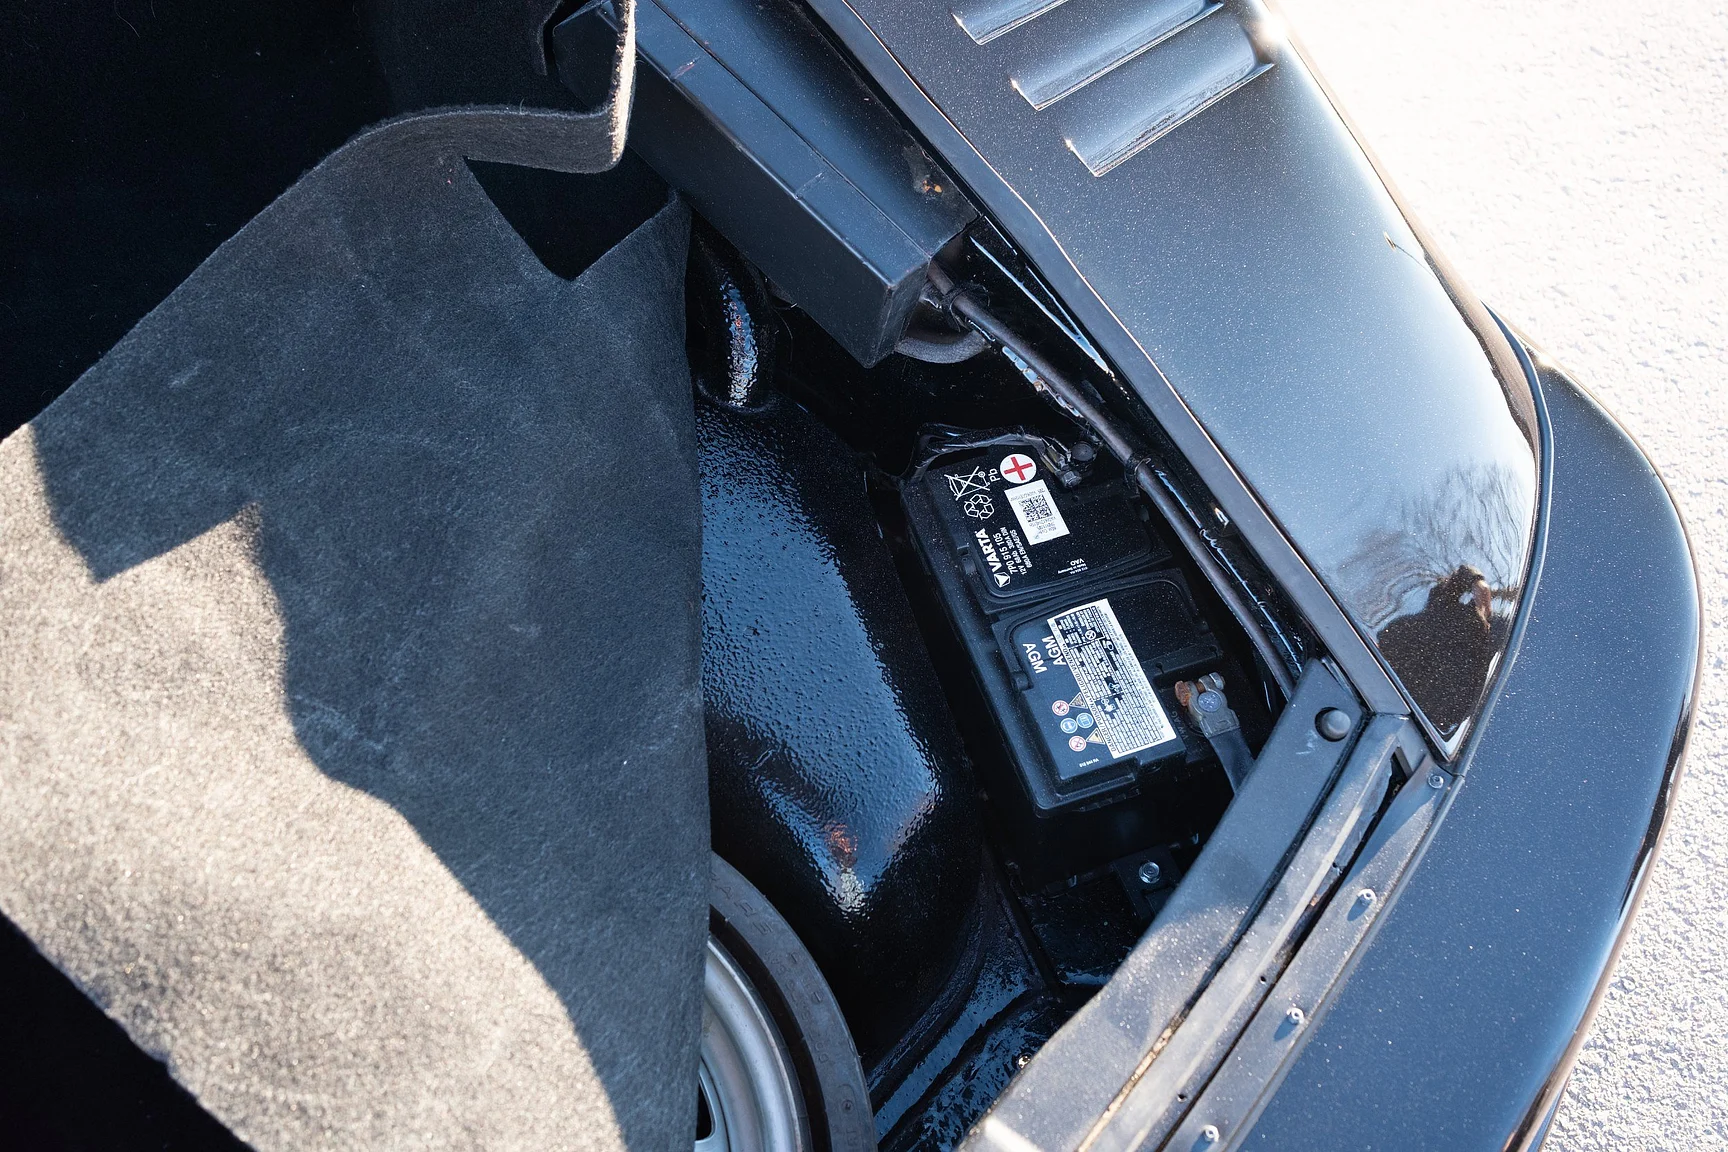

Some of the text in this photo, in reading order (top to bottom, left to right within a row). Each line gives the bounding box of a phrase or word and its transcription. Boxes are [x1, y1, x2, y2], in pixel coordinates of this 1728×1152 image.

[986, 467, 1001, 482] Pb
[975, 527, 1002, 572] VARTA
[992, 531, 1005, 546] 105
[999, 545, 1012, 560] 915
[1018, 564, 1027, 575] 12V
[1021, 642, 1048, 674] AGM
[1040, 634, 1067, 666] AGM
[1169, 710, 1188, 740] VW AG
